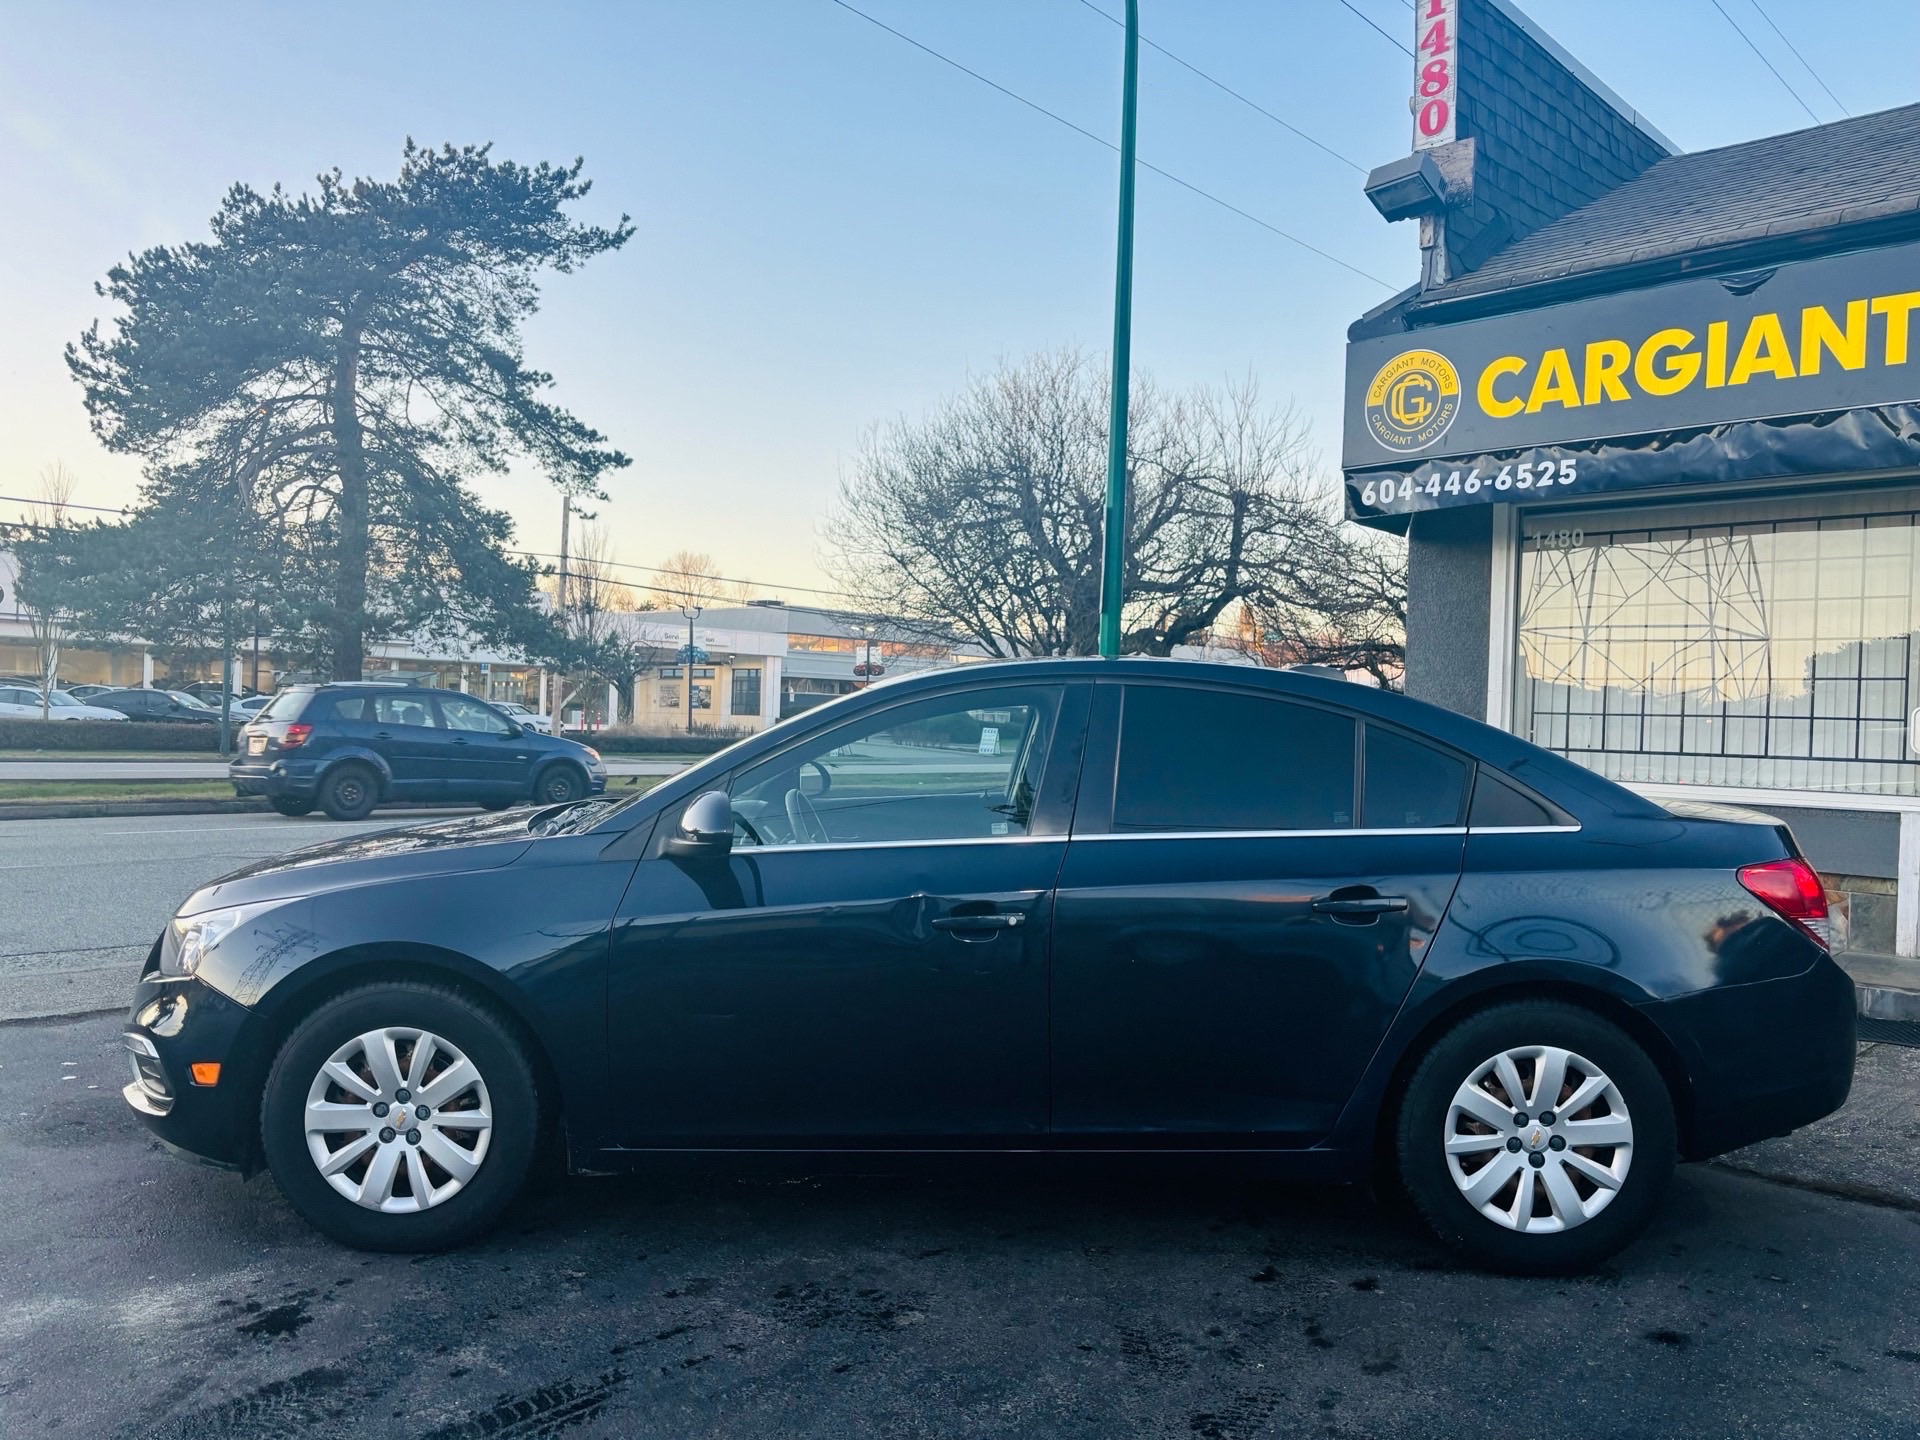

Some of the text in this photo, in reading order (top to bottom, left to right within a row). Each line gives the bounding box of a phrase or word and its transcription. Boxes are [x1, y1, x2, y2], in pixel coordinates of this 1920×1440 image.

[1477, 291, 1920, 418] CARGIANT
[1373, 357, 1453, 398] CARGIANT MOTORS
[1372, 403, 1453, 445] CARGIANT MOTORS
[1361, 458, 1578, 506] 604-446-6525
[1532, 528, 1585, 549] 1480
